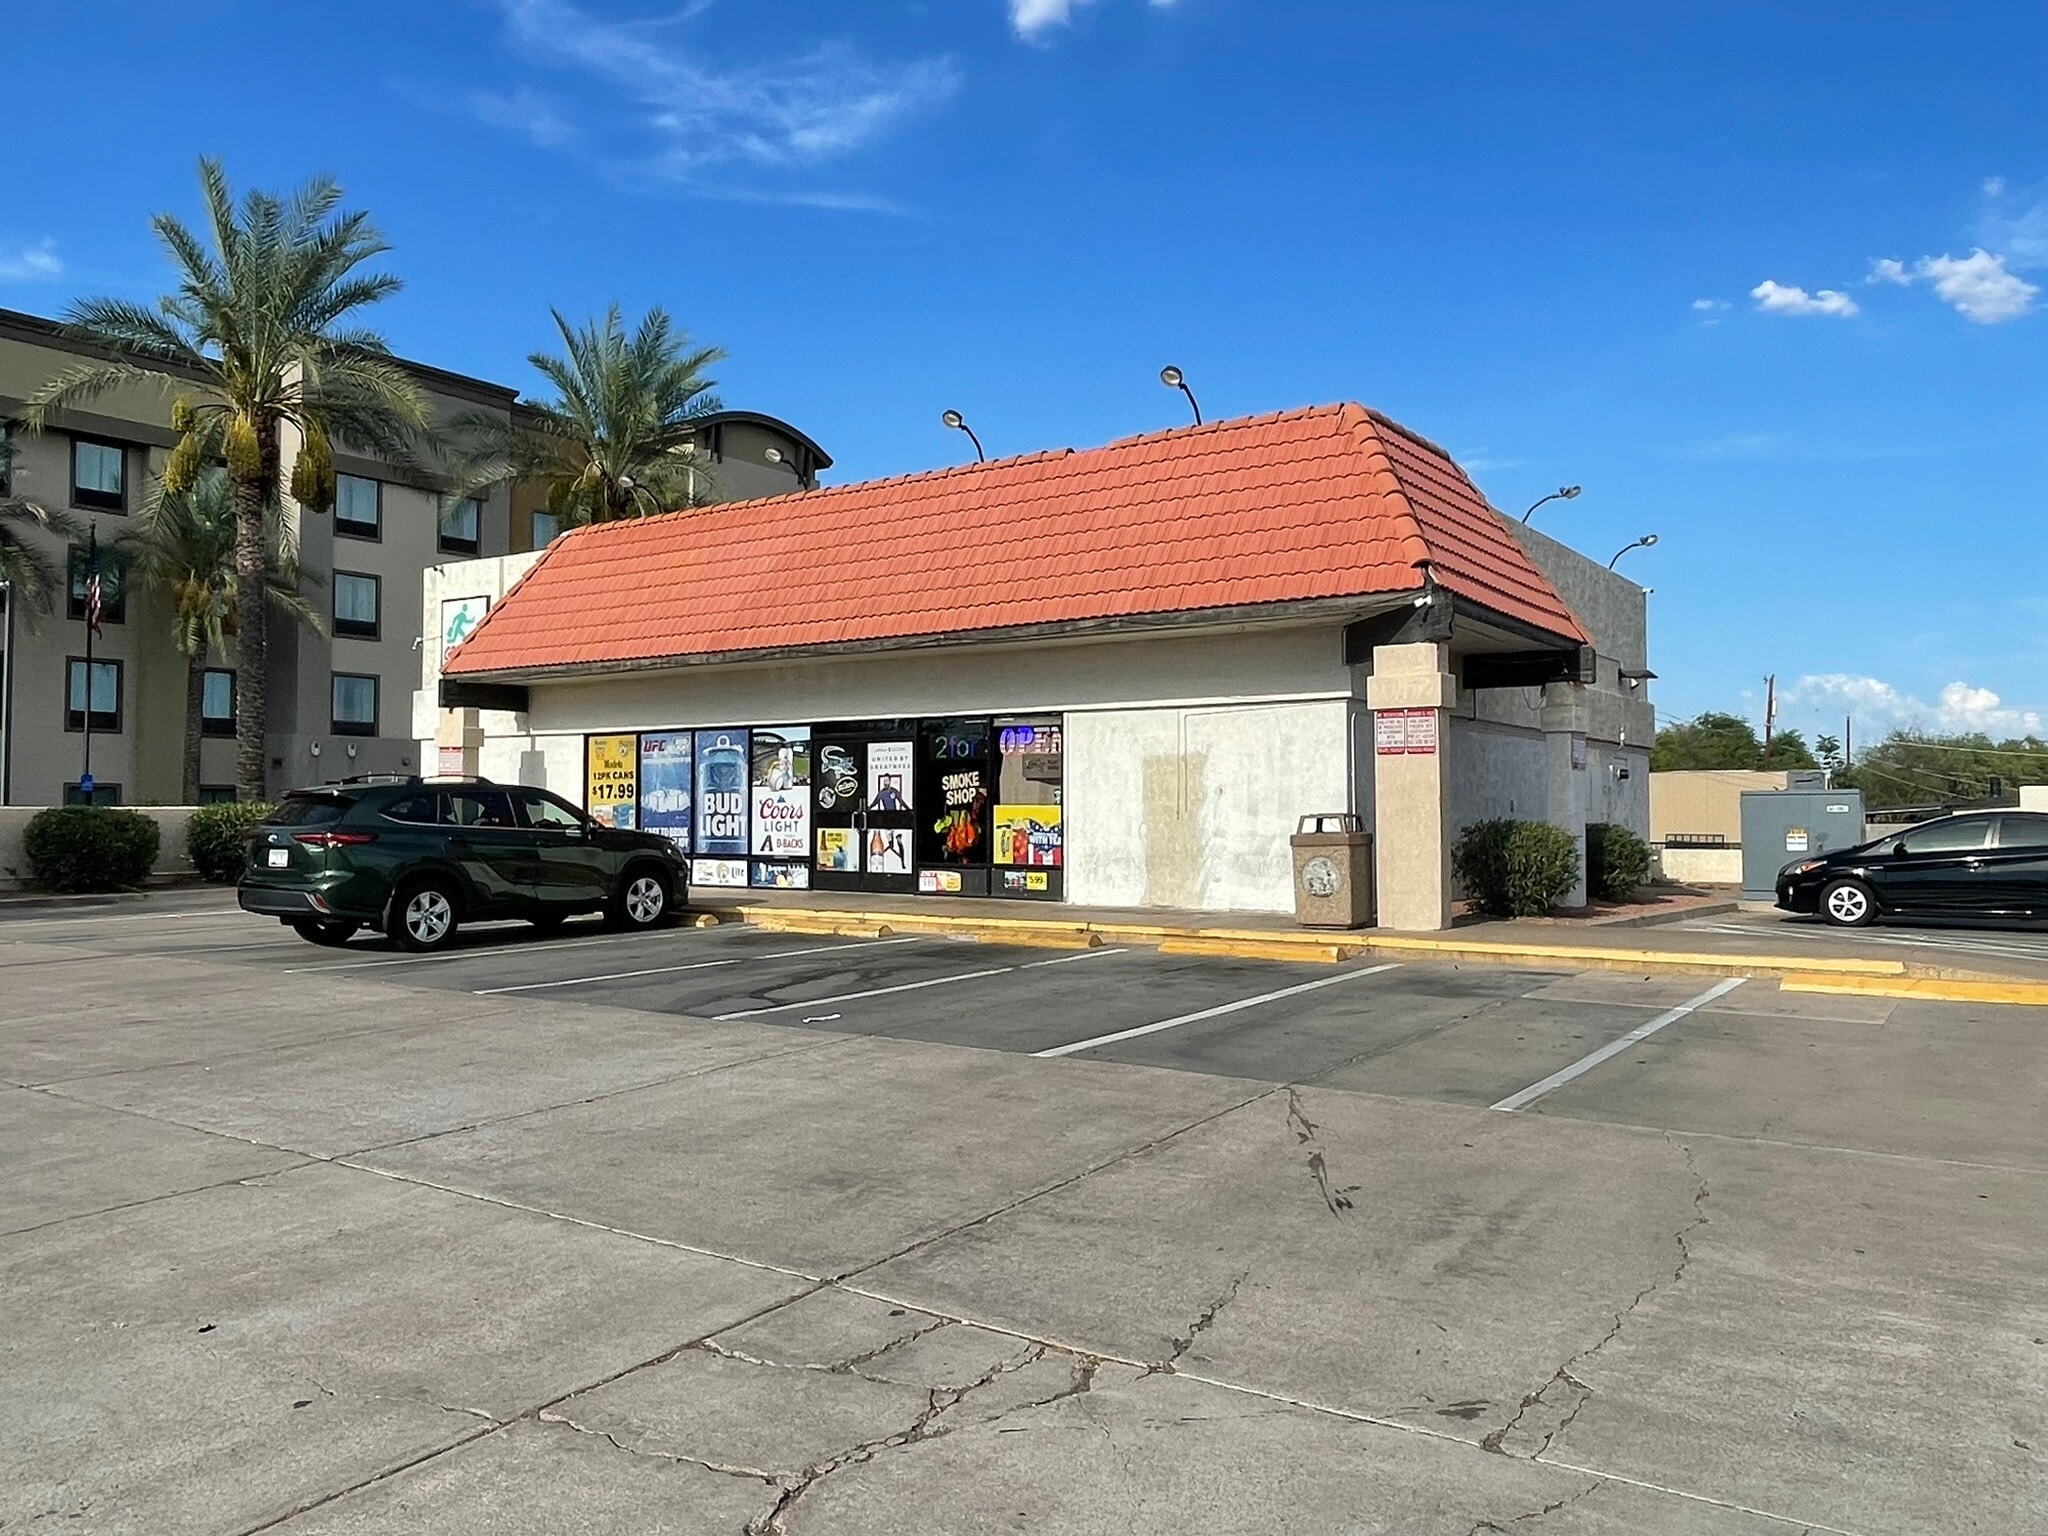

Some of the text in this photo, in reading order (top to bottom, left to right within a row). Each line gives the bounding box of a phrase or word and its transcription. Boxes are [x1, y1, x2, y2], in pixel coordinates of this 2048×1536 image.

[644, 739, 666, 752] UFC
[612, 770, 634, 779] CANS
[942, 771, 980, 791] SMOKE
[592, 783, 634, 799] $17.99
[946, 787, 977, 806] SHOP
[704, 792, 742, 814] BUD
[759, 797, 804, 820] Coors
[699, 814, 748, 837] LIGHT
[764, 820, 799, 832] LIGHT
